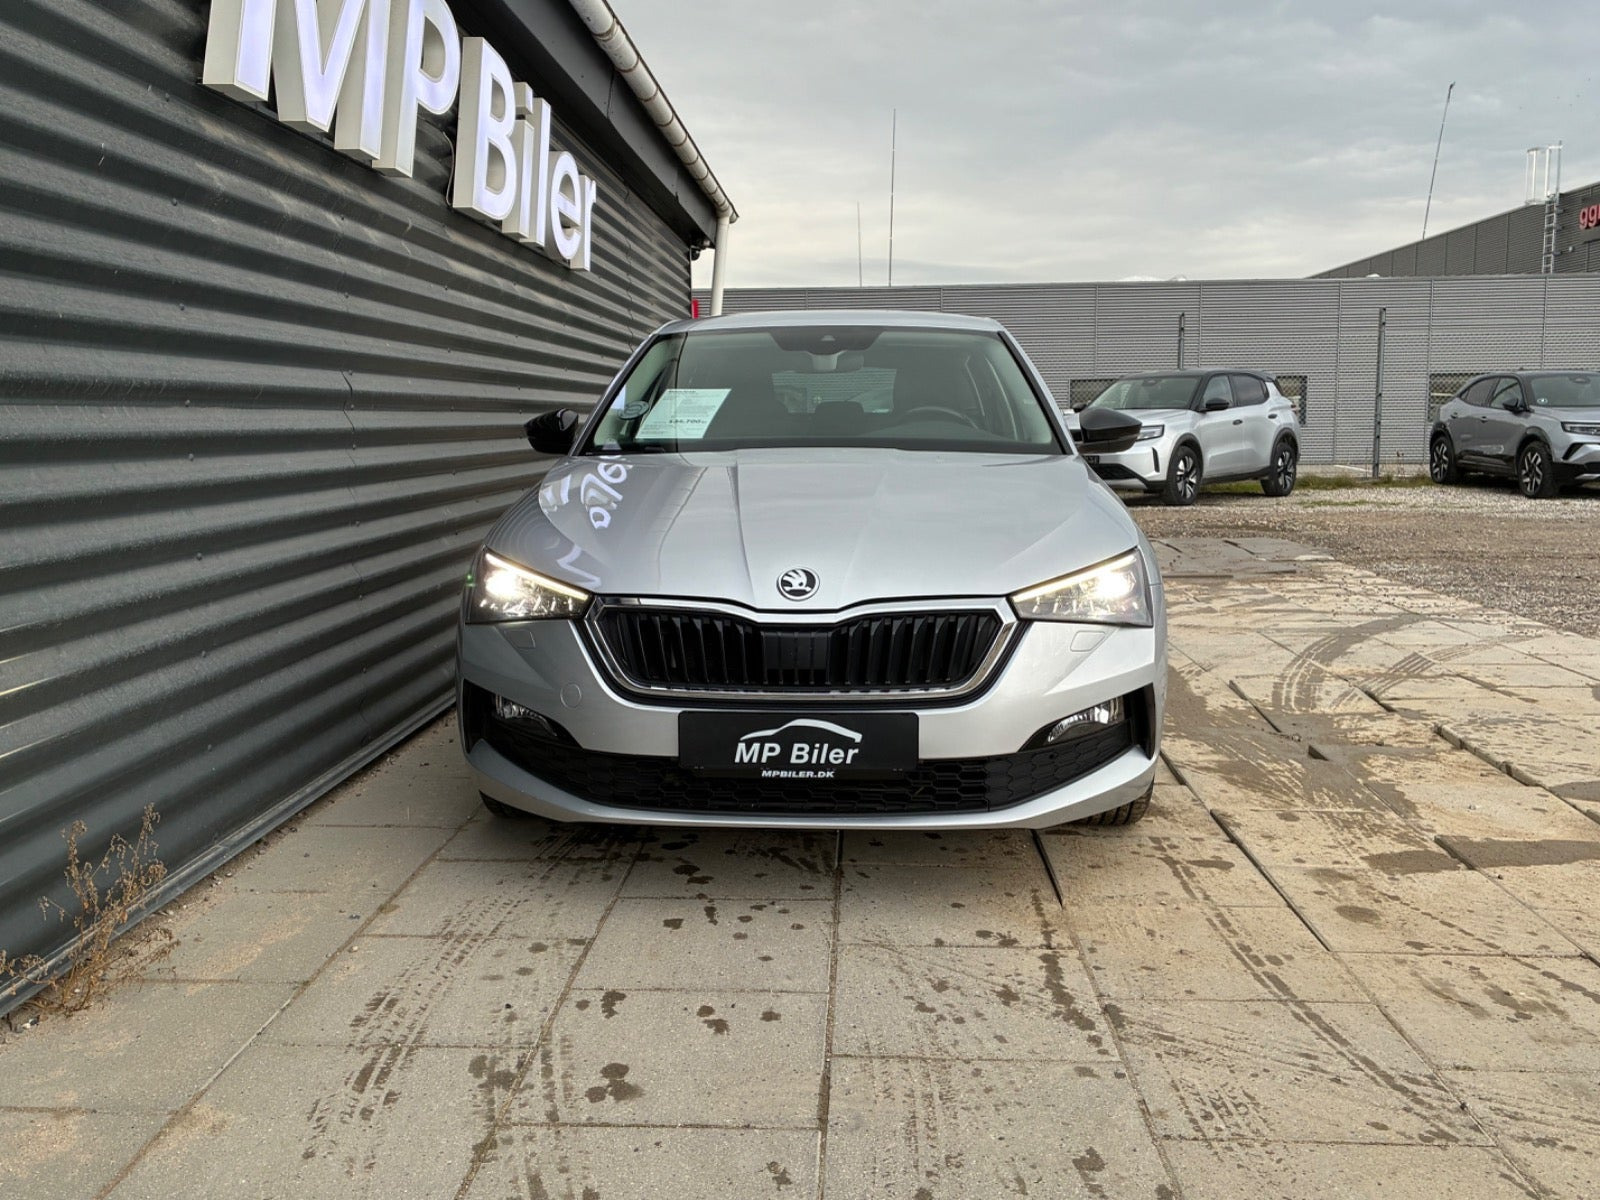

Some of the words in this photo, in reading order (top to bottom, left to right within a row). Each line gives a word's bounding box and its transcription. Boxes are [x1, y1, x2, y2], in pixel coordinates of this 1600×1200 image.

[203, 0, 461, 177] MP
[453, 37, 596, 271] Biler
[735, 743, 780, 763] MP
[790, 743, 859, 764] Biler
[761, 769, 835, 778] MPBILER.DK
